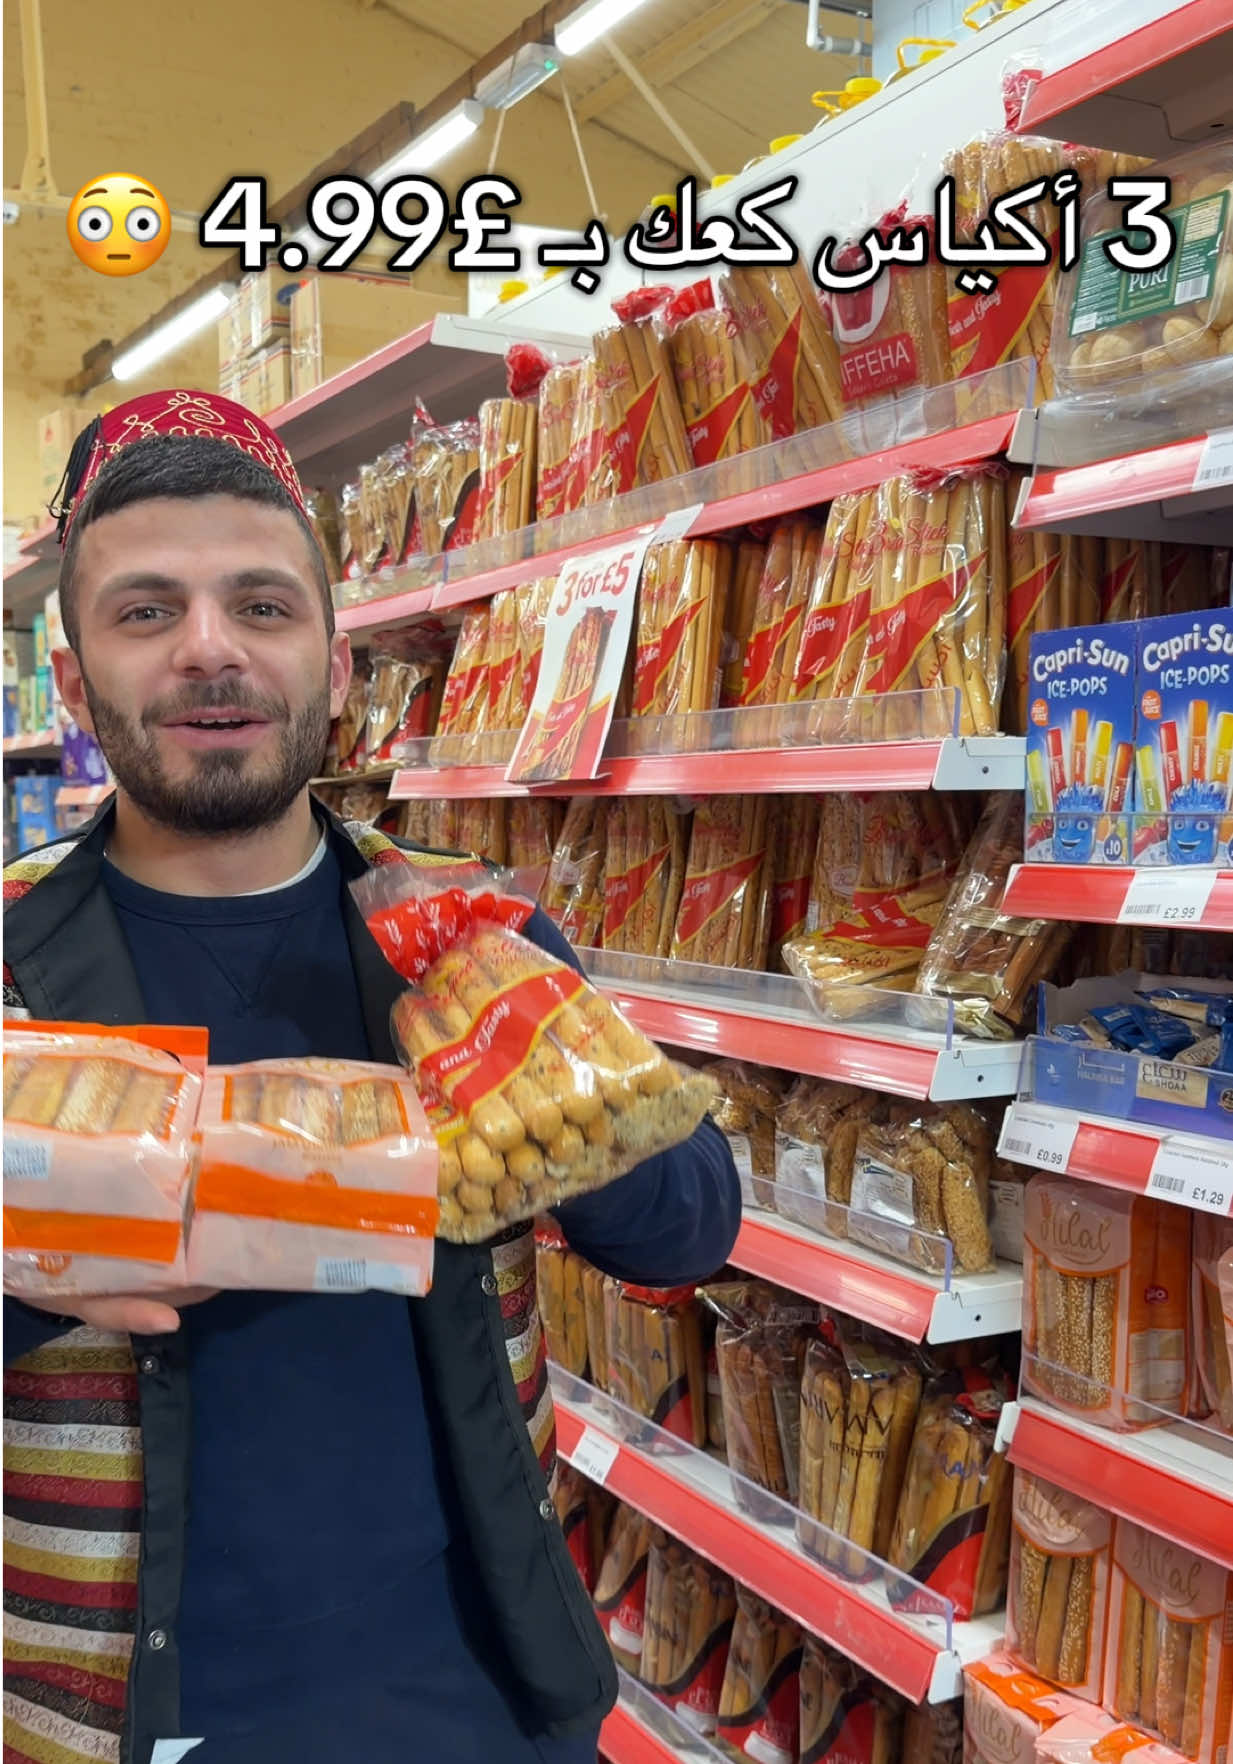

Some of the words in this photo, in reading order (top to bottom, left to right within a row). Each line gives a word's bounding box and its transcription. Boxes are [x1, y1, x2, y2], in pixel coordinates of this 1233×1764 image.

[840, 341, 911, 385] IFFEHA
[555, 571, 578, 617] 3
[575, 571, 602, 601] for
[600, 551, 635, 597] £5
[1033, 637, 1130, 682] Capri-Sun
[1142, 623, 1233, 672] Capri-Su
[1047, 676, 1108, 699] ICE-POPS
[1160, 664, 1230, 690] ICE-POPS
[1162, 906, 1196, 919] £2.99
[473, 1000, 511, 1053] Tasty
[1036, 1148, 1064, 1166] £0.99
[1191, 1186, 1225, 1206] £1.29
